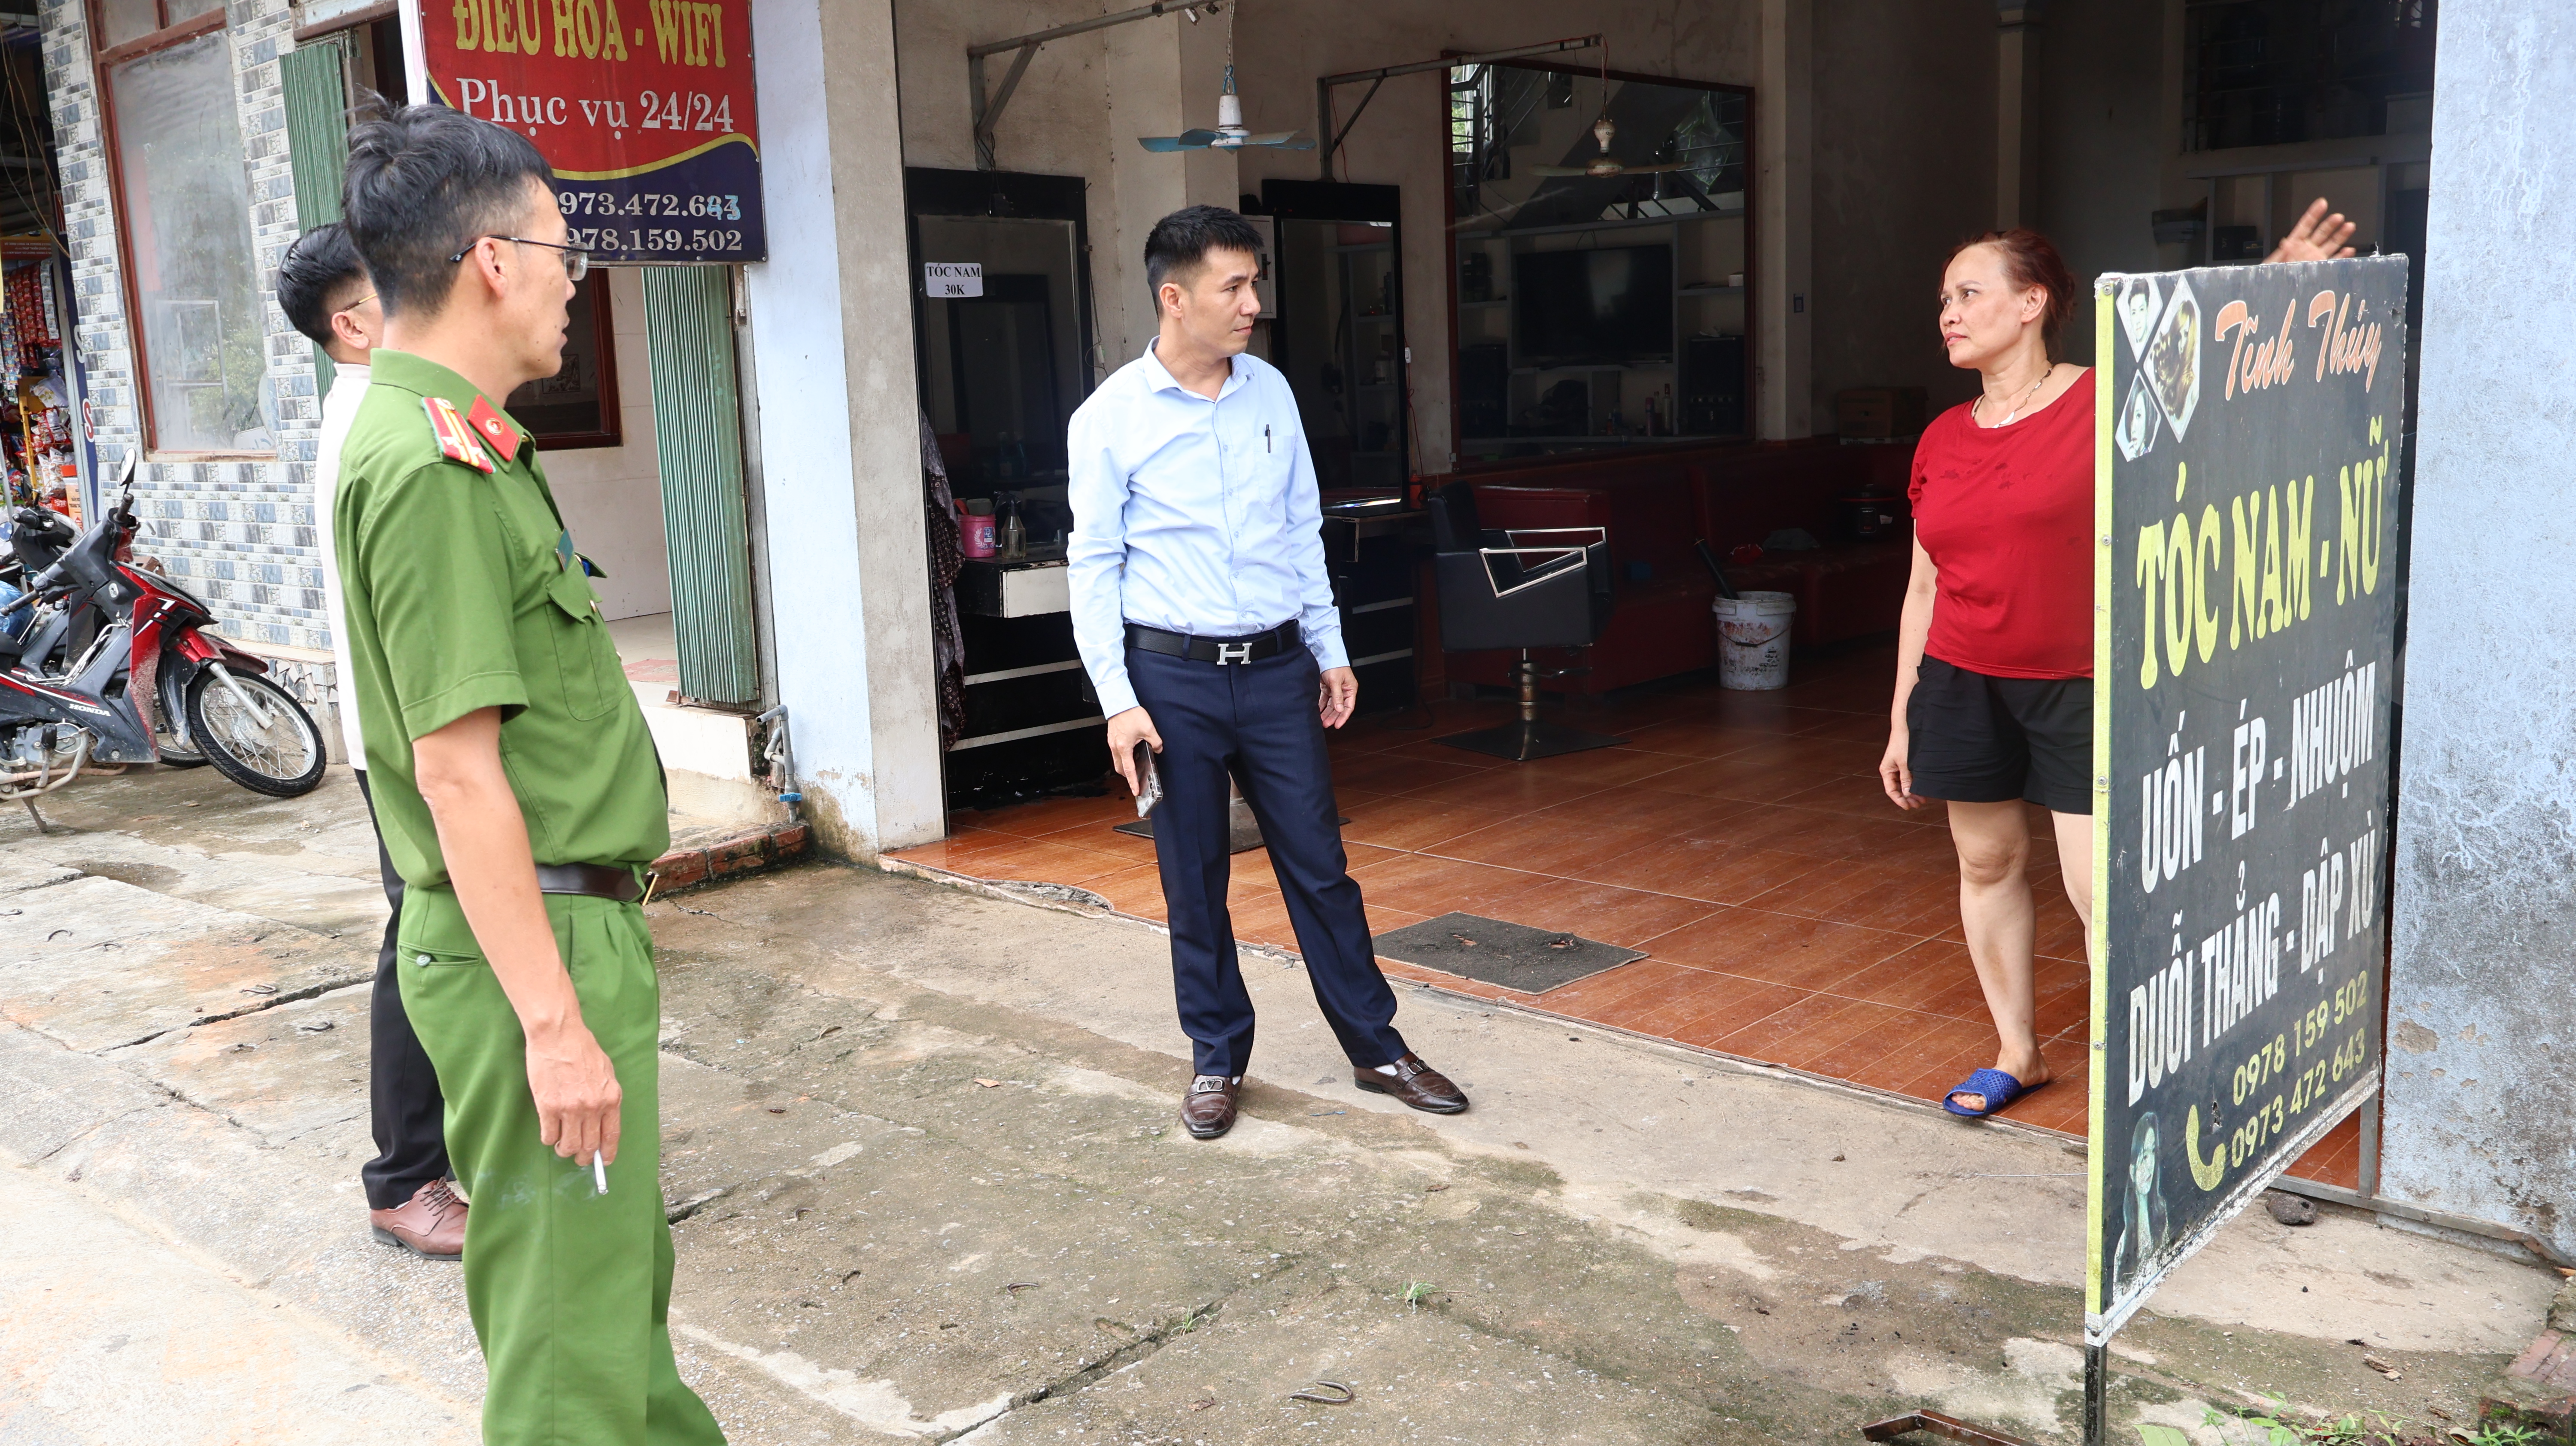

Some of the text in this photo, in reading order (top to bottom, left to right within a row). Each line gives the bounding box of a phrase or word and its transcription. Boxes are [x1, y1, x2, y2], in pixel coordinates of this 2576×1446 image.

[635, 28, 643, 46] -
[650, 0, 726, 68] WIFI
[456, 77, 734, 140] Phục vụ 24/24
[553, 191, 741, 220] 973.472.643
[567, 228, 742, 251] 978.159.502
[927, 263, 981, 277] TÓC NAM
[945, 284, 966, 295] 30K
[2137, 415, 2389, 690] TÓC NAM - NỮ
[69, 703, 111, 717] HONDA
[2142, 649, 2376, 893] UỐN - ÉP - NHUỘM
[2129, 810, 2376, 1108] DUỖI THẲNG - DẬP XÙ
[2233, 970, 2367, 1106] 0978 159 502
[2231, 1027, 2365, 1168] 0973 472 643
